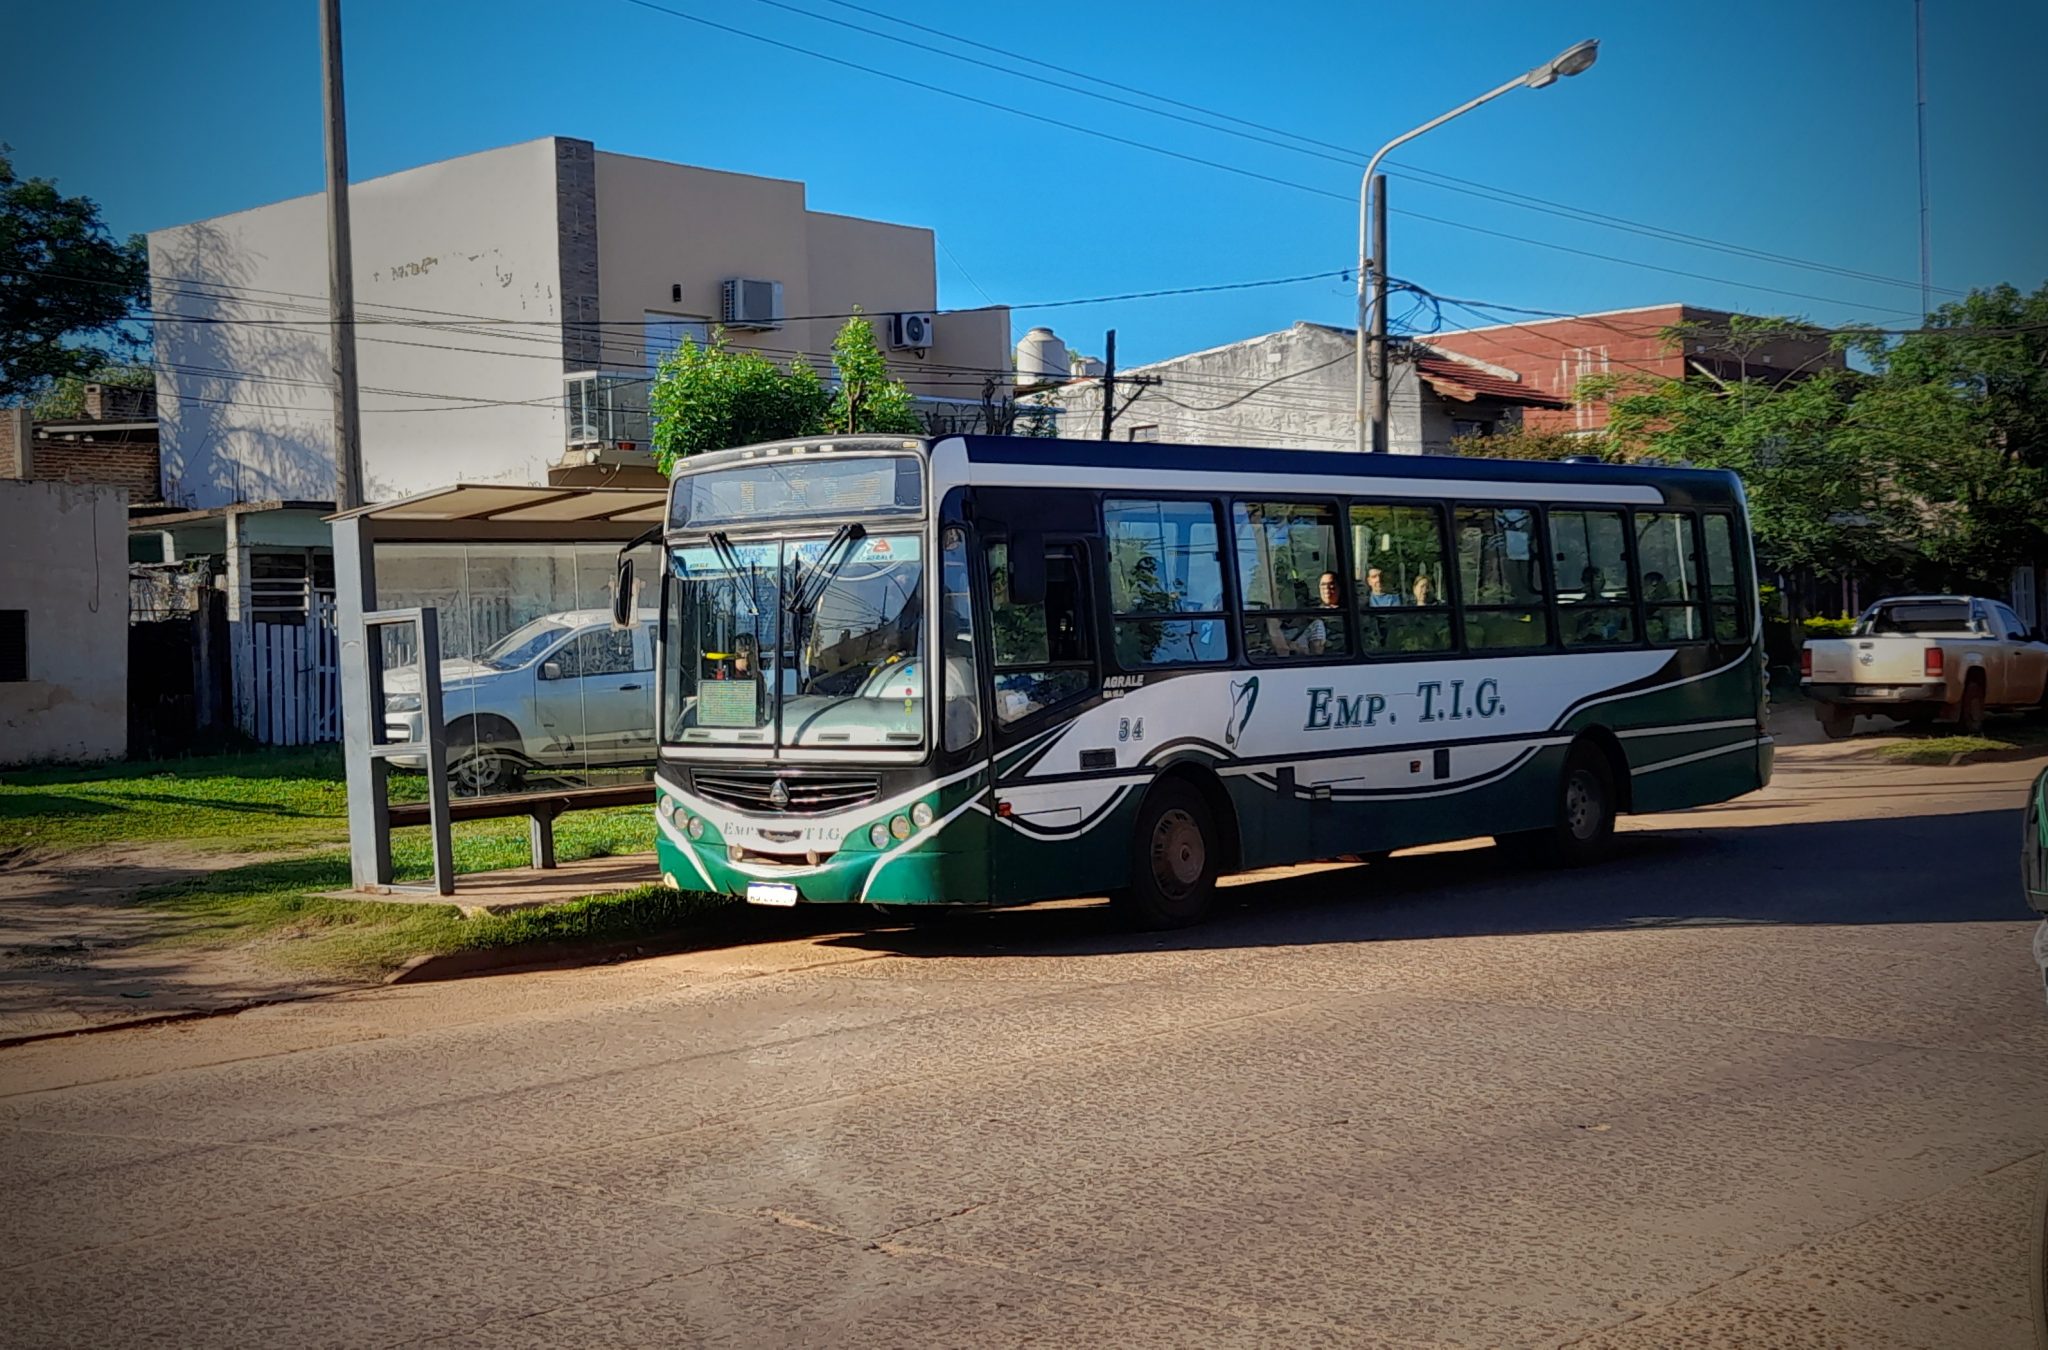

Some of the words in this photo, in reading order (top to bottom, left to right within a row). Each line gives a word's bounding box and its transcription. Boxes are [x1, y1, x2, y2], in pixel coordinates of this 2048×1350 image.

[1103, 674, 1144, 688] AGRALE
[1417, 678, 1505, 722] T.I.G.
[1119, 717, 1144, 742] 34
